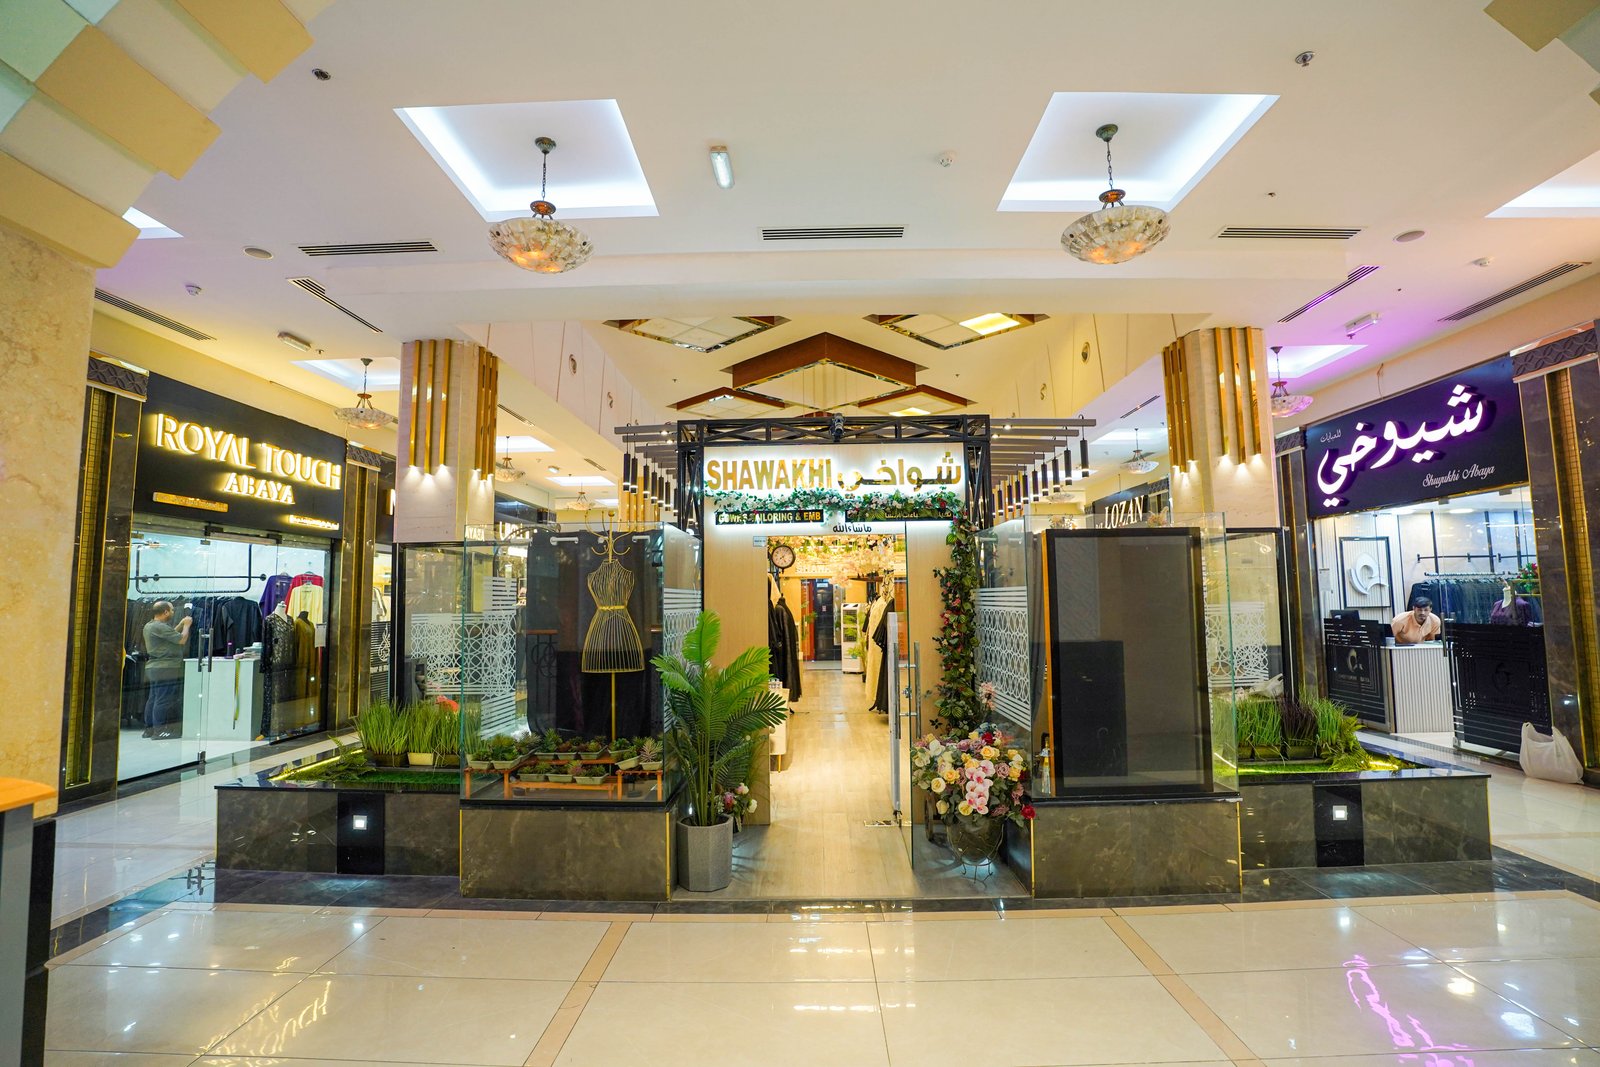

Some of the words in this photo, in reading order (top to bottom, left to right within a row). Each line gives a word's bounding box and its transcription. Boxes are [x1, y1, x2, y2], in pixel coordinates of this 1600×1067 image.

[156, 413, 256, 469] ROYAL
[258, 443, 342, 490] TOUCH
[1317, 384, 1483, 507] شيوخي
[707, 459, 831, 490] SHAWAKHI
[1462, 463, 1496, 480] Abaya
[222, 472, 296, 505] ABAYA
[803, 511, 821, 520] EMB
[1105, 495, 1144, 529] LOZAN
